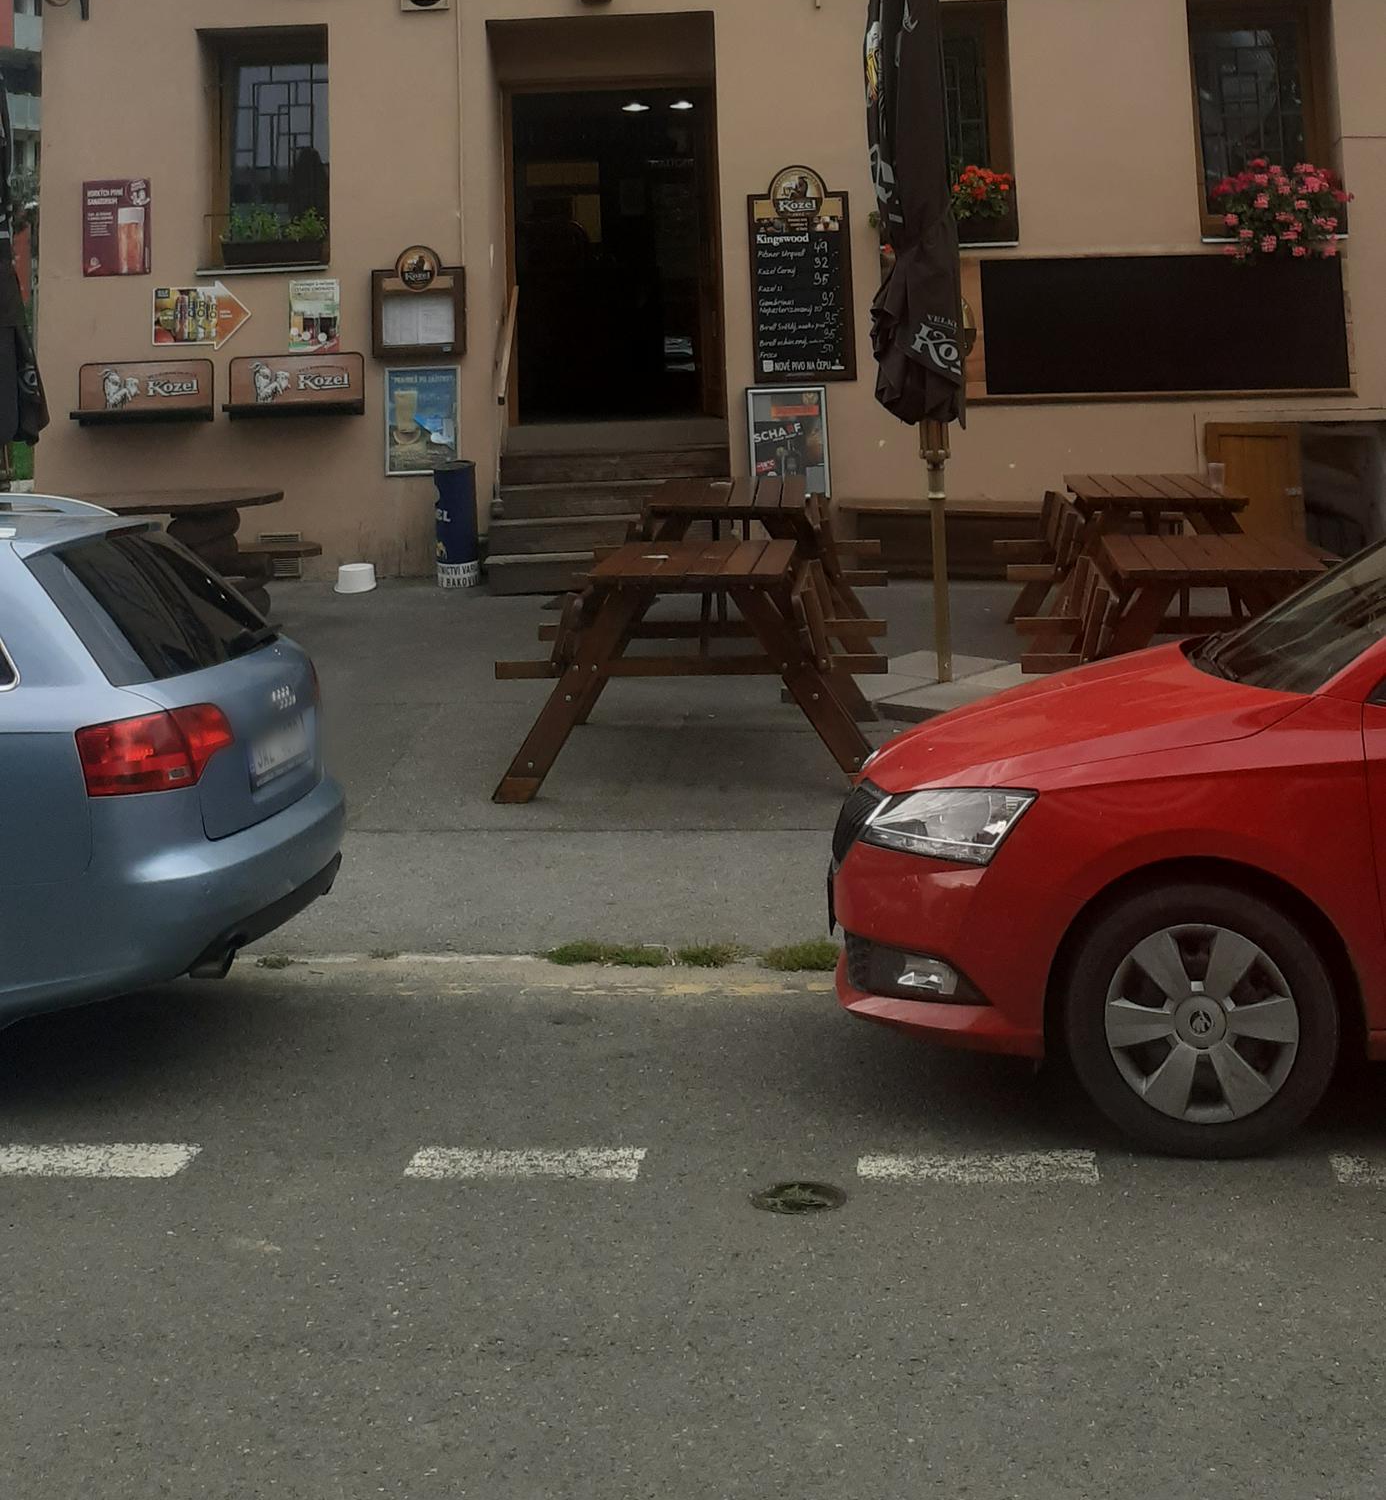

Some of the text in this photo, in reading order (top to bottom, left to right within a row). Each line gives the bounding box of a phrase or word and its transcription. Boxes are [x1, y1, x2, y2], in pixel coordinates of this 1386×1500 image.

[779, 199, 816, 212] Kozel
[756, 233, 809, 246] Kingswood
[774, 359, 791, 371] NOVÉ
[791, 361, 806, 371] PIVO
[806, 361, 815, 370] NA
[147, 379, 199, 396] Kozel
[297, 373, 349, 390] Kozel
